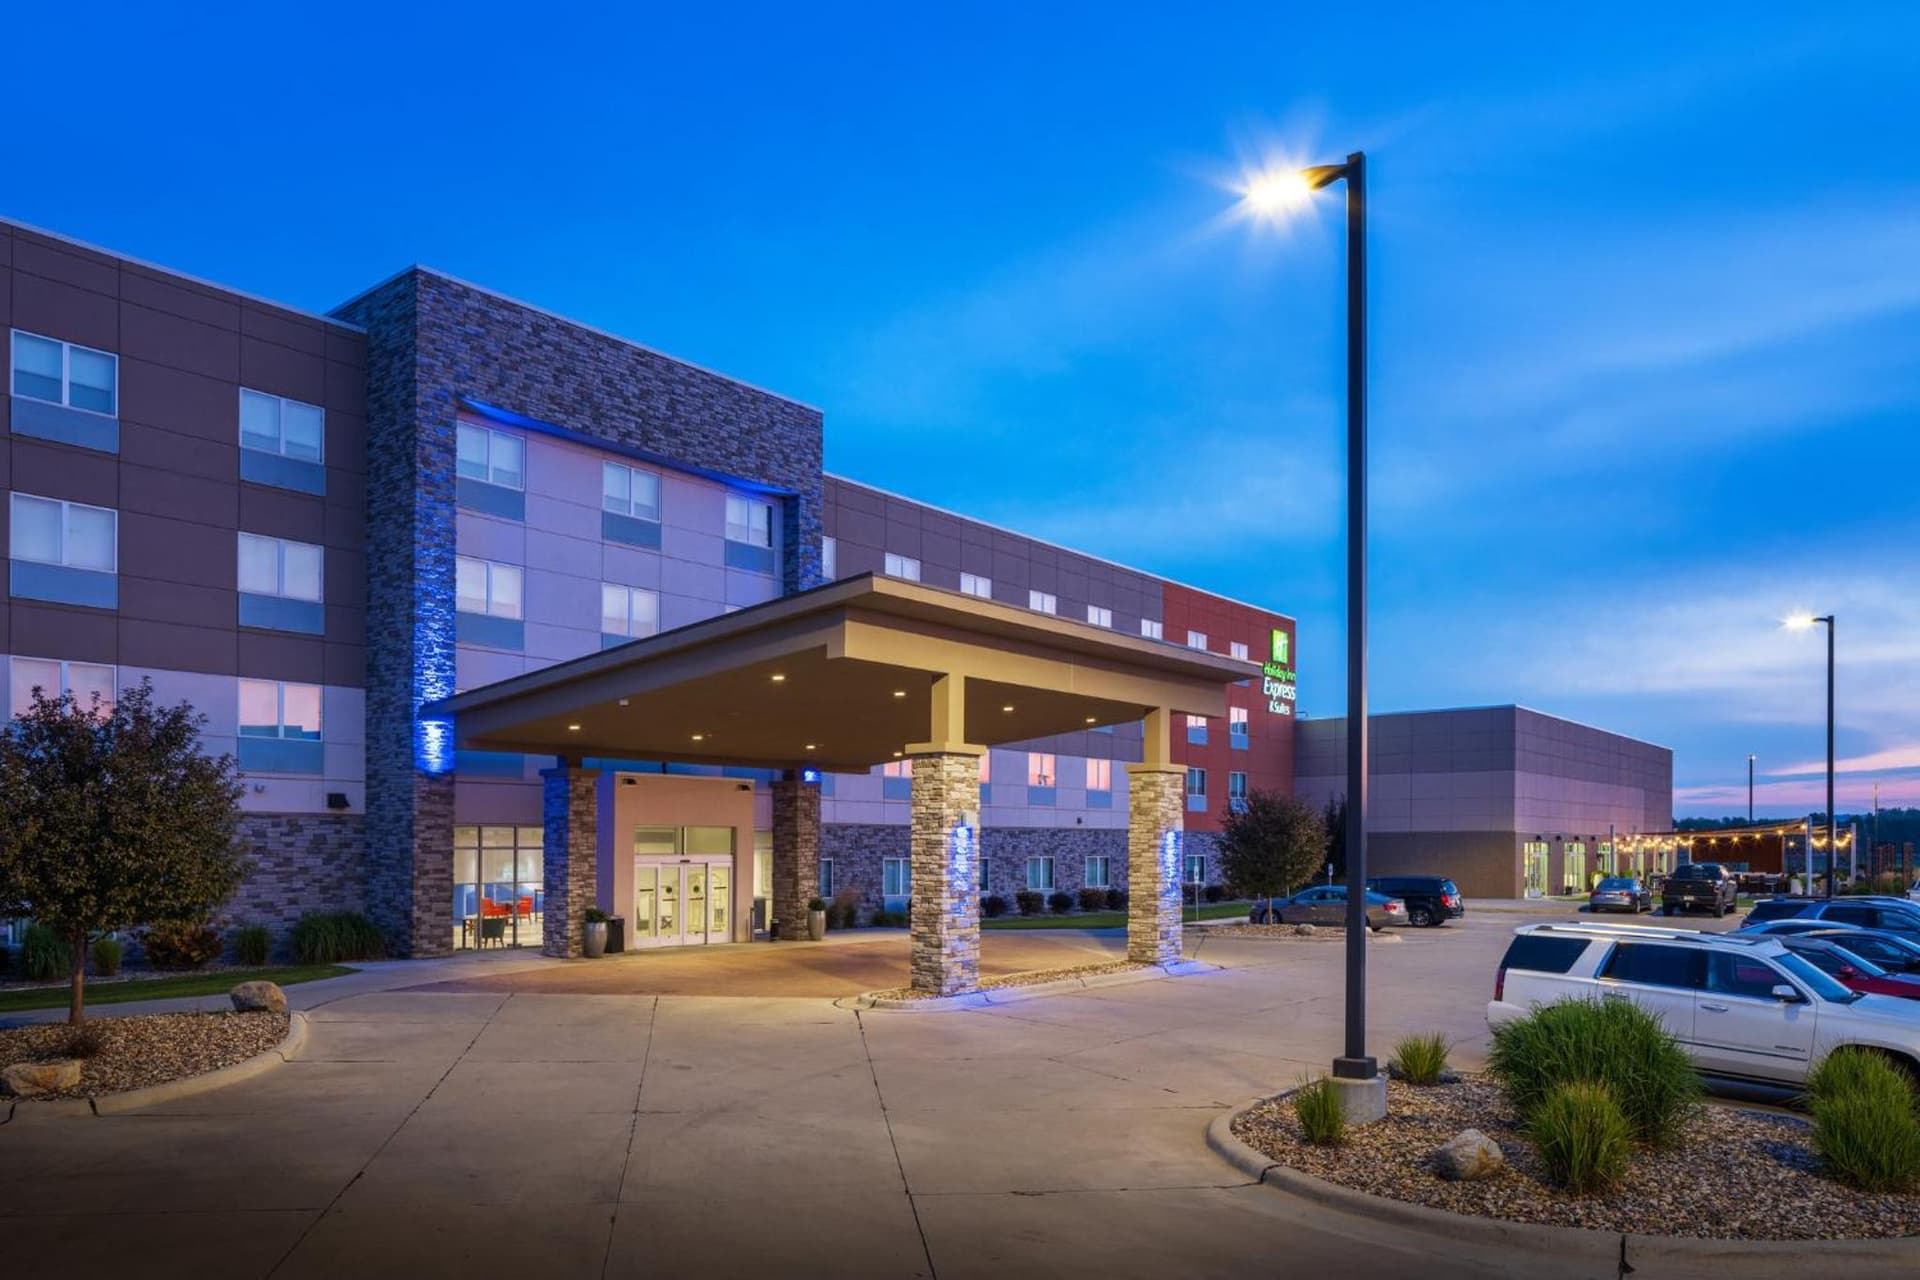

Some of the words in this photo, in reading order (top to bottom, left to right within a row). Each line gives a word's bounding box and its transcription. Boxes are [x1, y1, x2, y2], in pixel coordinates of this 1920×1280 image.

[1264, 661, 1286, 682] Holiday
[1263, 677, 1296, 701] Express
[1274, 701, 1290, 715] Suites
